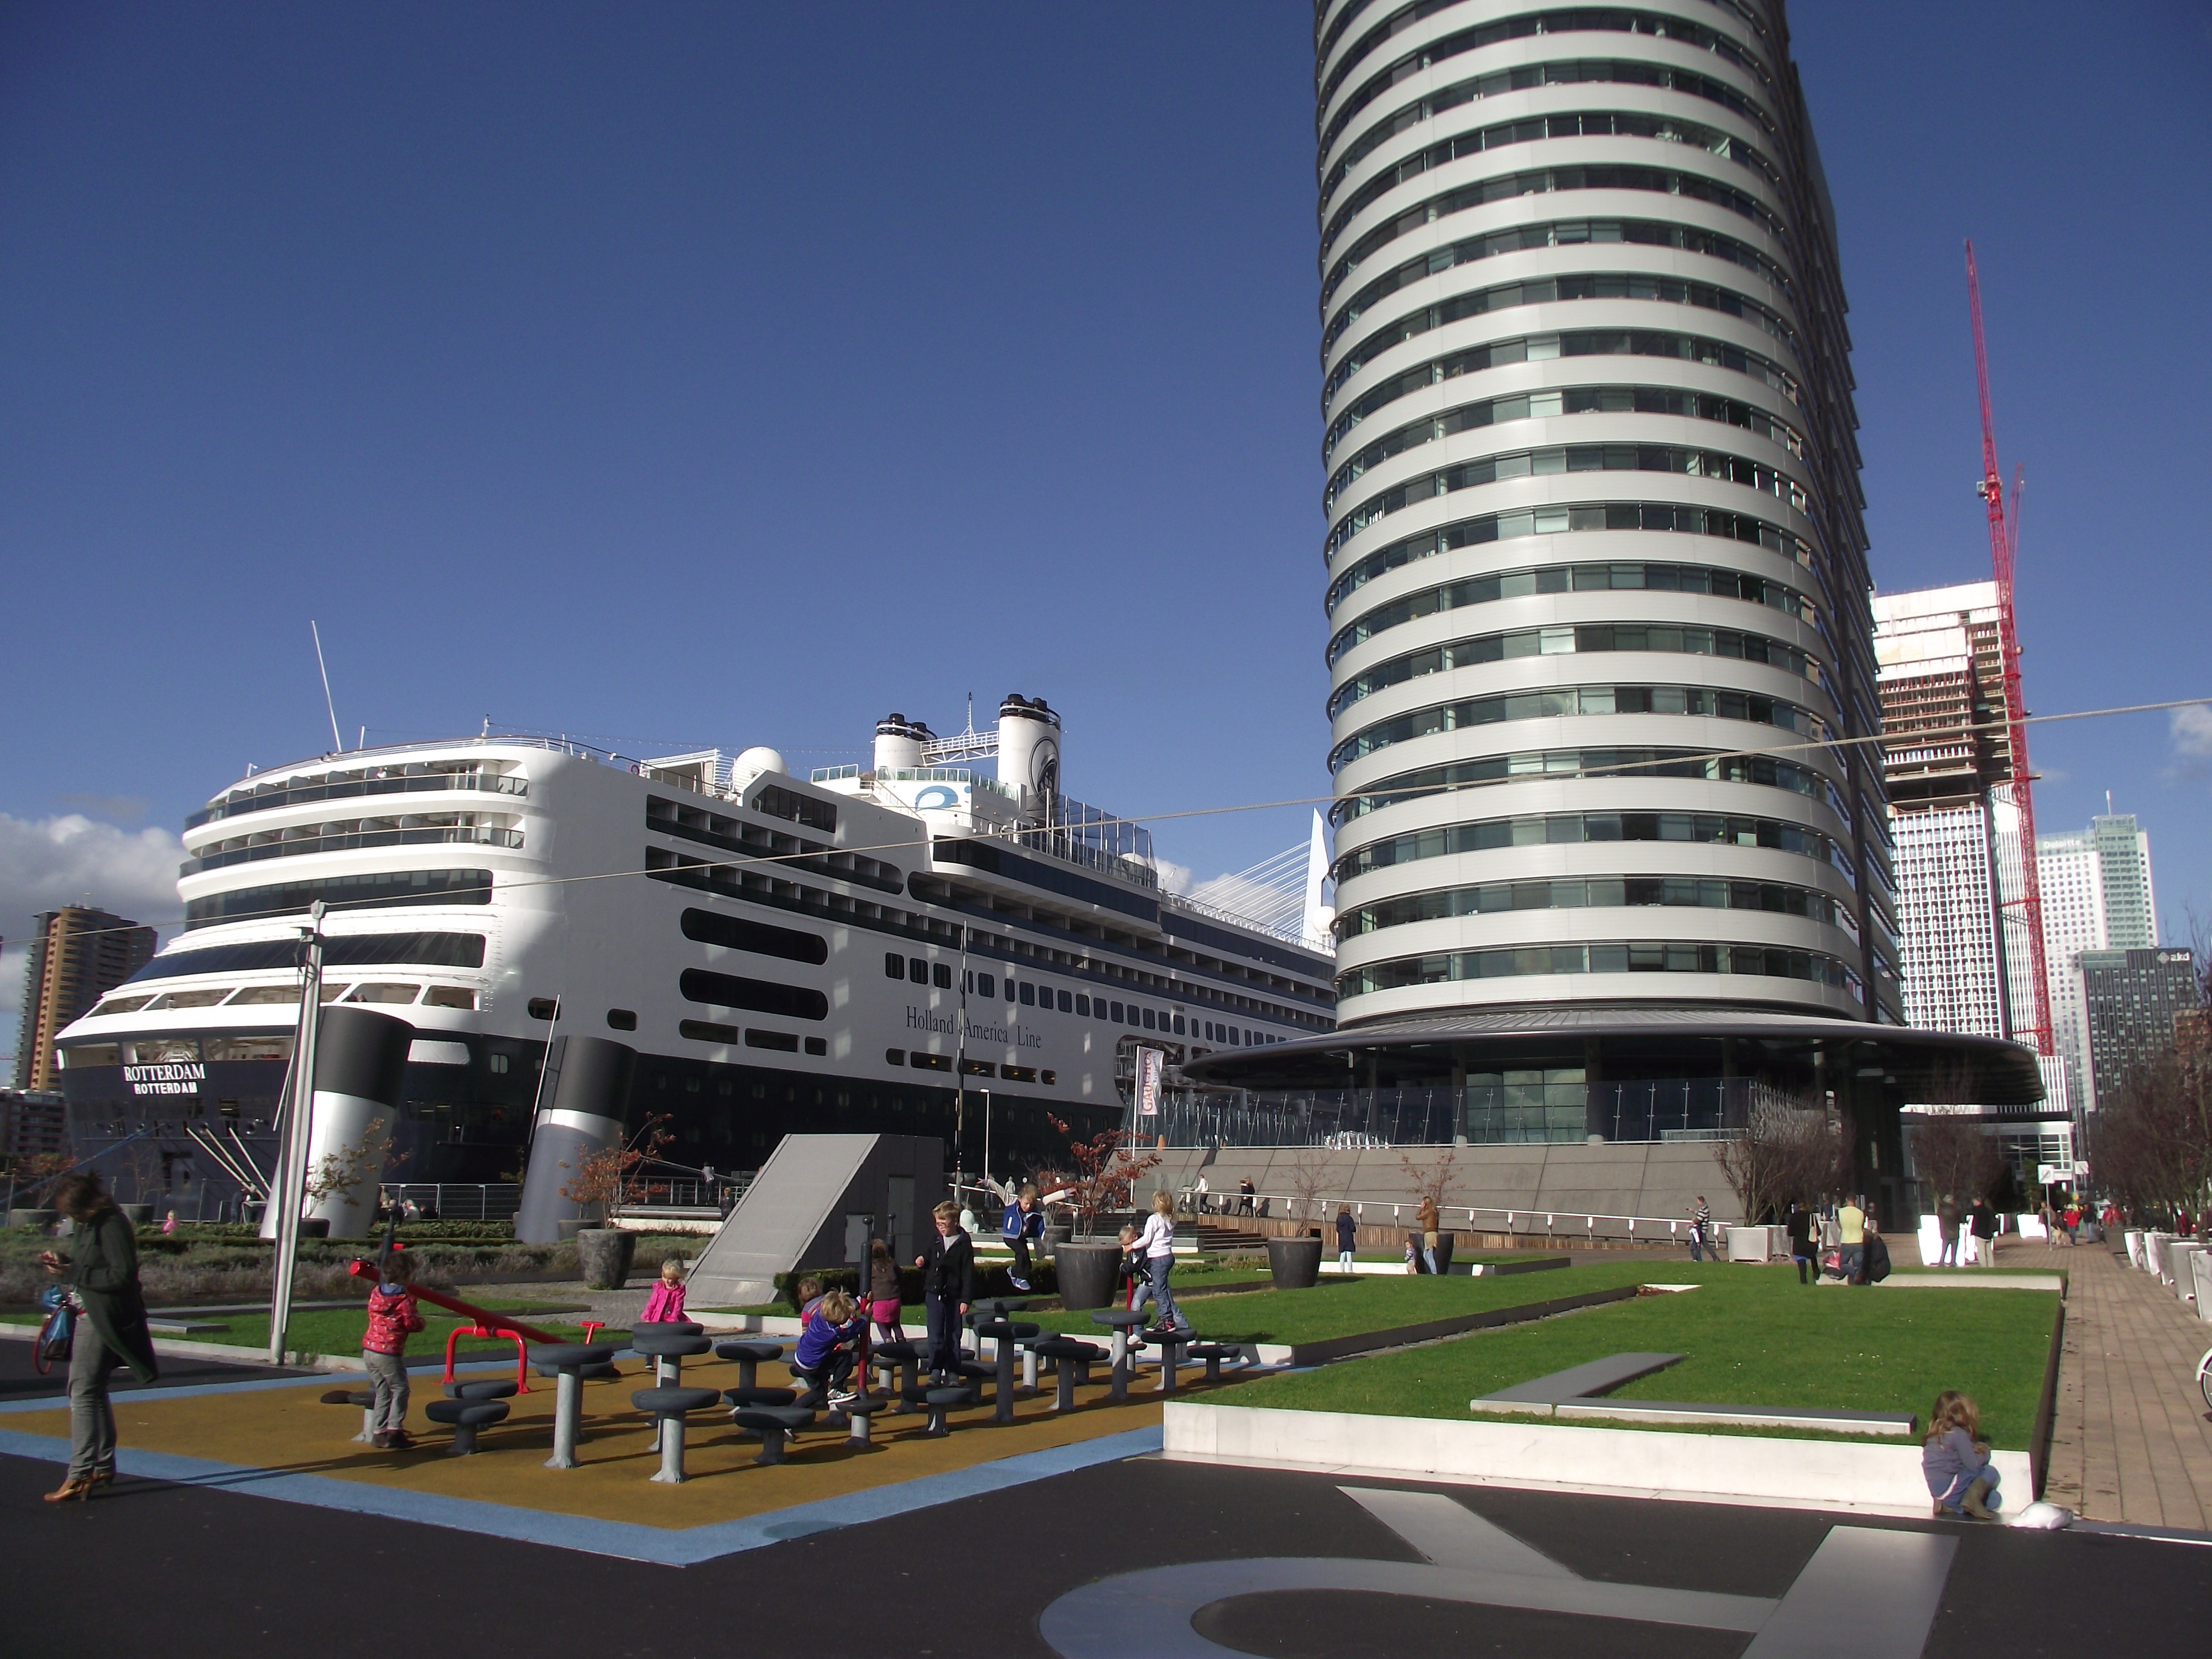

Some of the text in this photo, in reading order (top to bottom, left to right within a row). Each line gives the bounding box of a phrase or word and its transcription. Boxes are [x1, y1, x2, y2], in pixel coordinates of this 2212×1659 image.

[2170, 952, 2190, 961] akd
[906, 1005, 1041, 1048] Holland America Line
[123, 1063, 206, 1082] ROTTERDAM
[1142, 1050, 1152, 1112] GAUCHOS
[134, 1082, 197, 1094] ROTTERDAM
